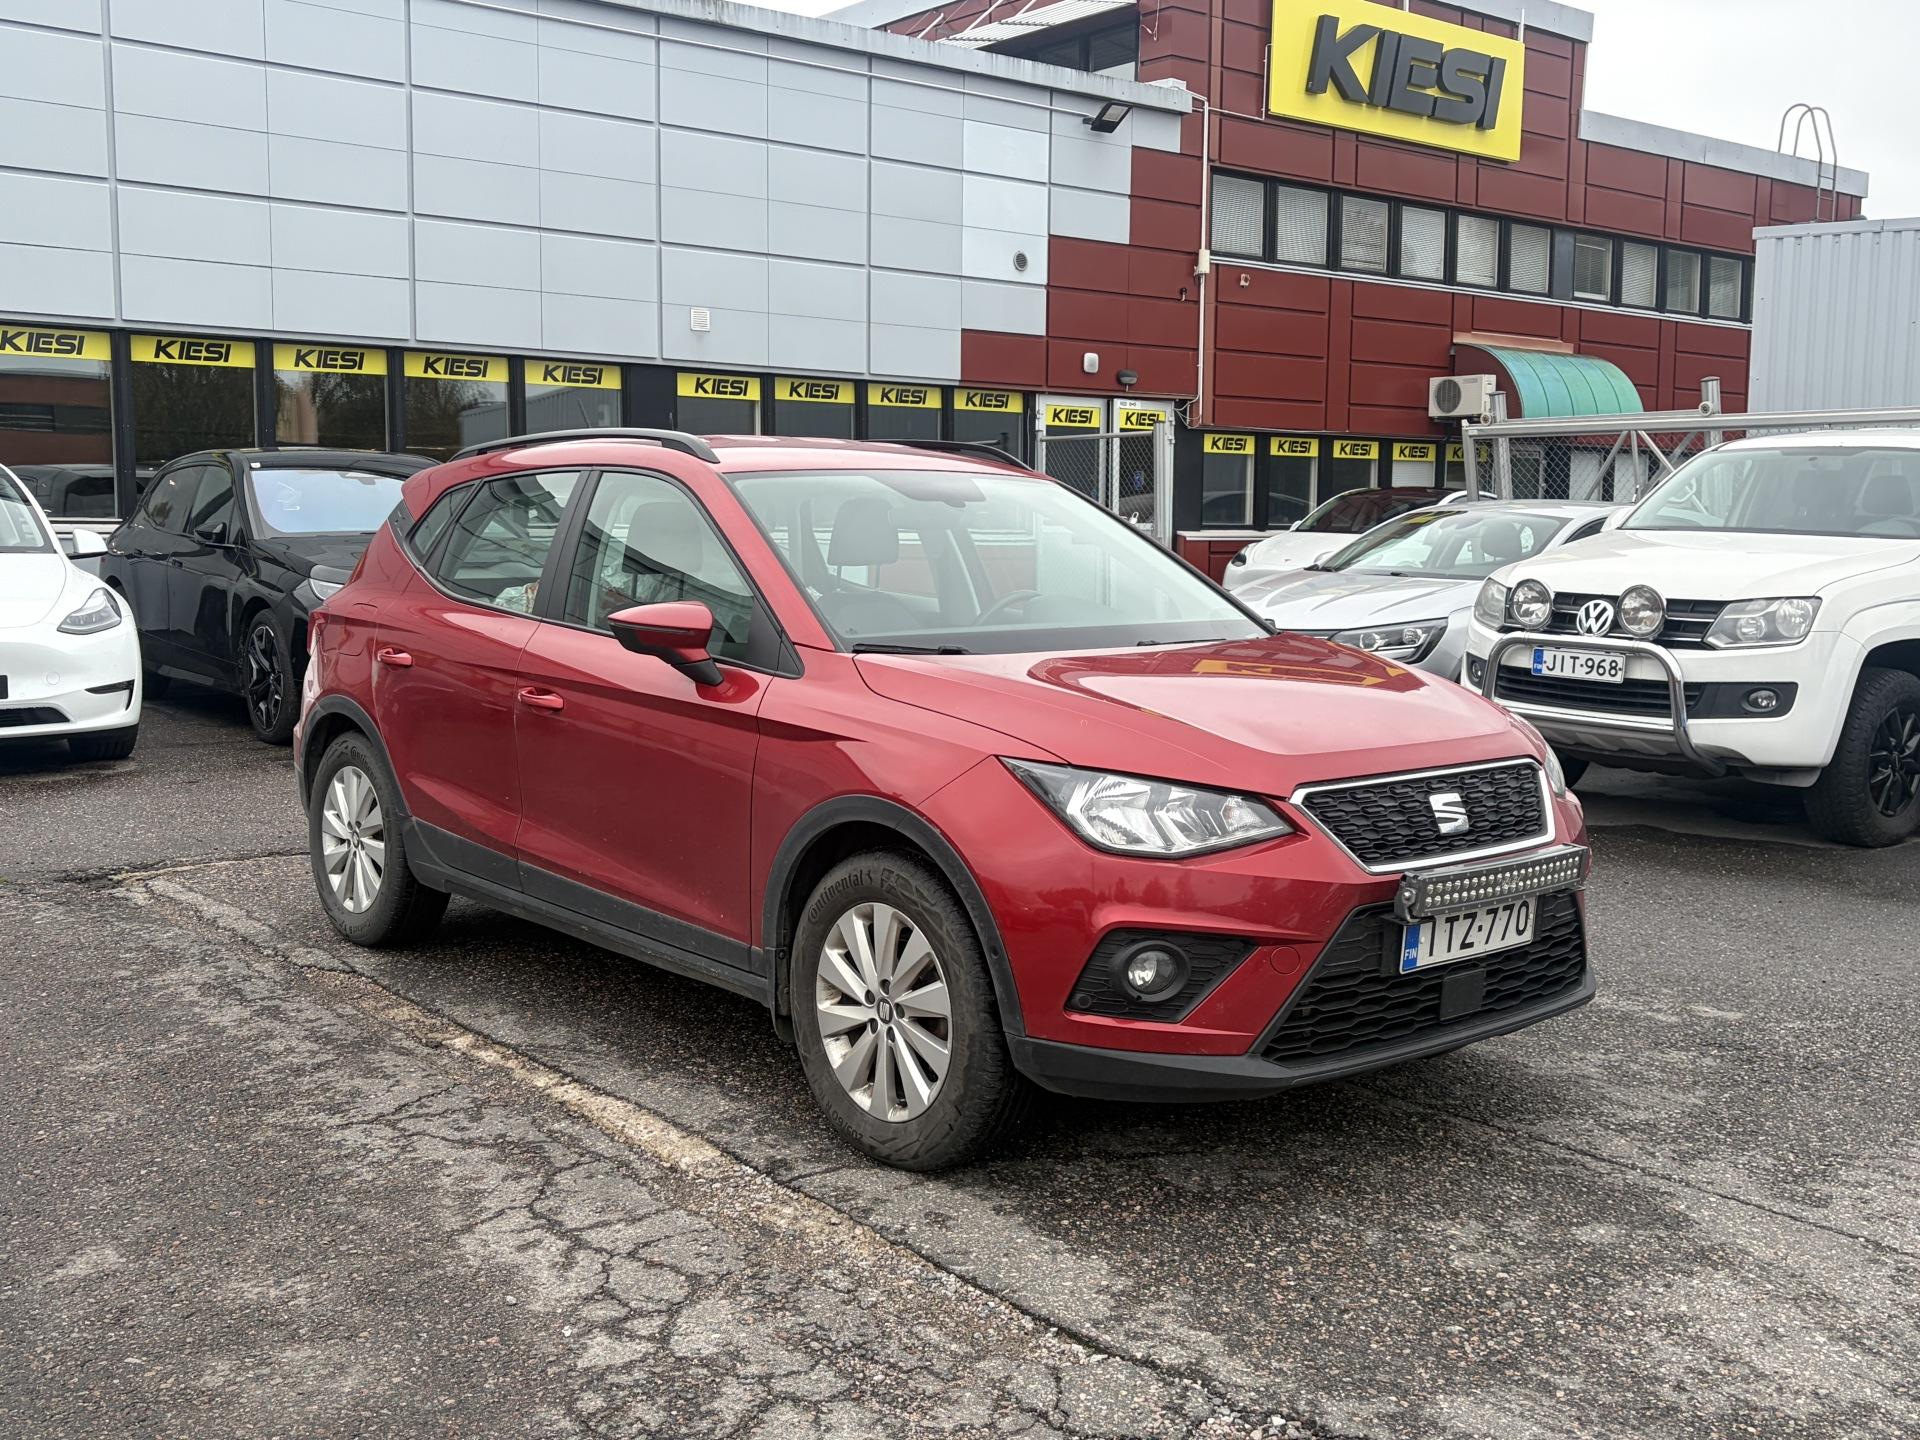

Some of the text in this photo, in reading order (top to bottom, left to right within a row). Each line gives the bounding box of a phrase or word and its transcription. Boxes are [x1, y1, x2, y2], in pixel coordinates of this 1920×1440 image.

[1306, 14, 1506, 131] KIESI
[0, 330, 85, 355] KIESI
[154, 339, 231, 362] KIESI
[294, 347, 365, 370] KIESI
[423, 355, 488, 377] KIESI
[542, 364, 603, 385] KIESI
[694, 376, 749, 397] KIESI
[788, 381, 839, 400] KIESI
[880, 386, 928, 405] KIESI
[965, 390, 1010, 410] KIESI
[1052, 408, 1093, 424] KIESI
[1210, 436, 1247, 452] KIESI
[1277, 440, 1312, 454] KIESI
[1339, 442, 1371, 457] KIESI
[1398, 445, 1430, 459] KIESI
[1545, 654, 1619, 678] JIT-968
[1403, 947, 1418, 960] FIN
